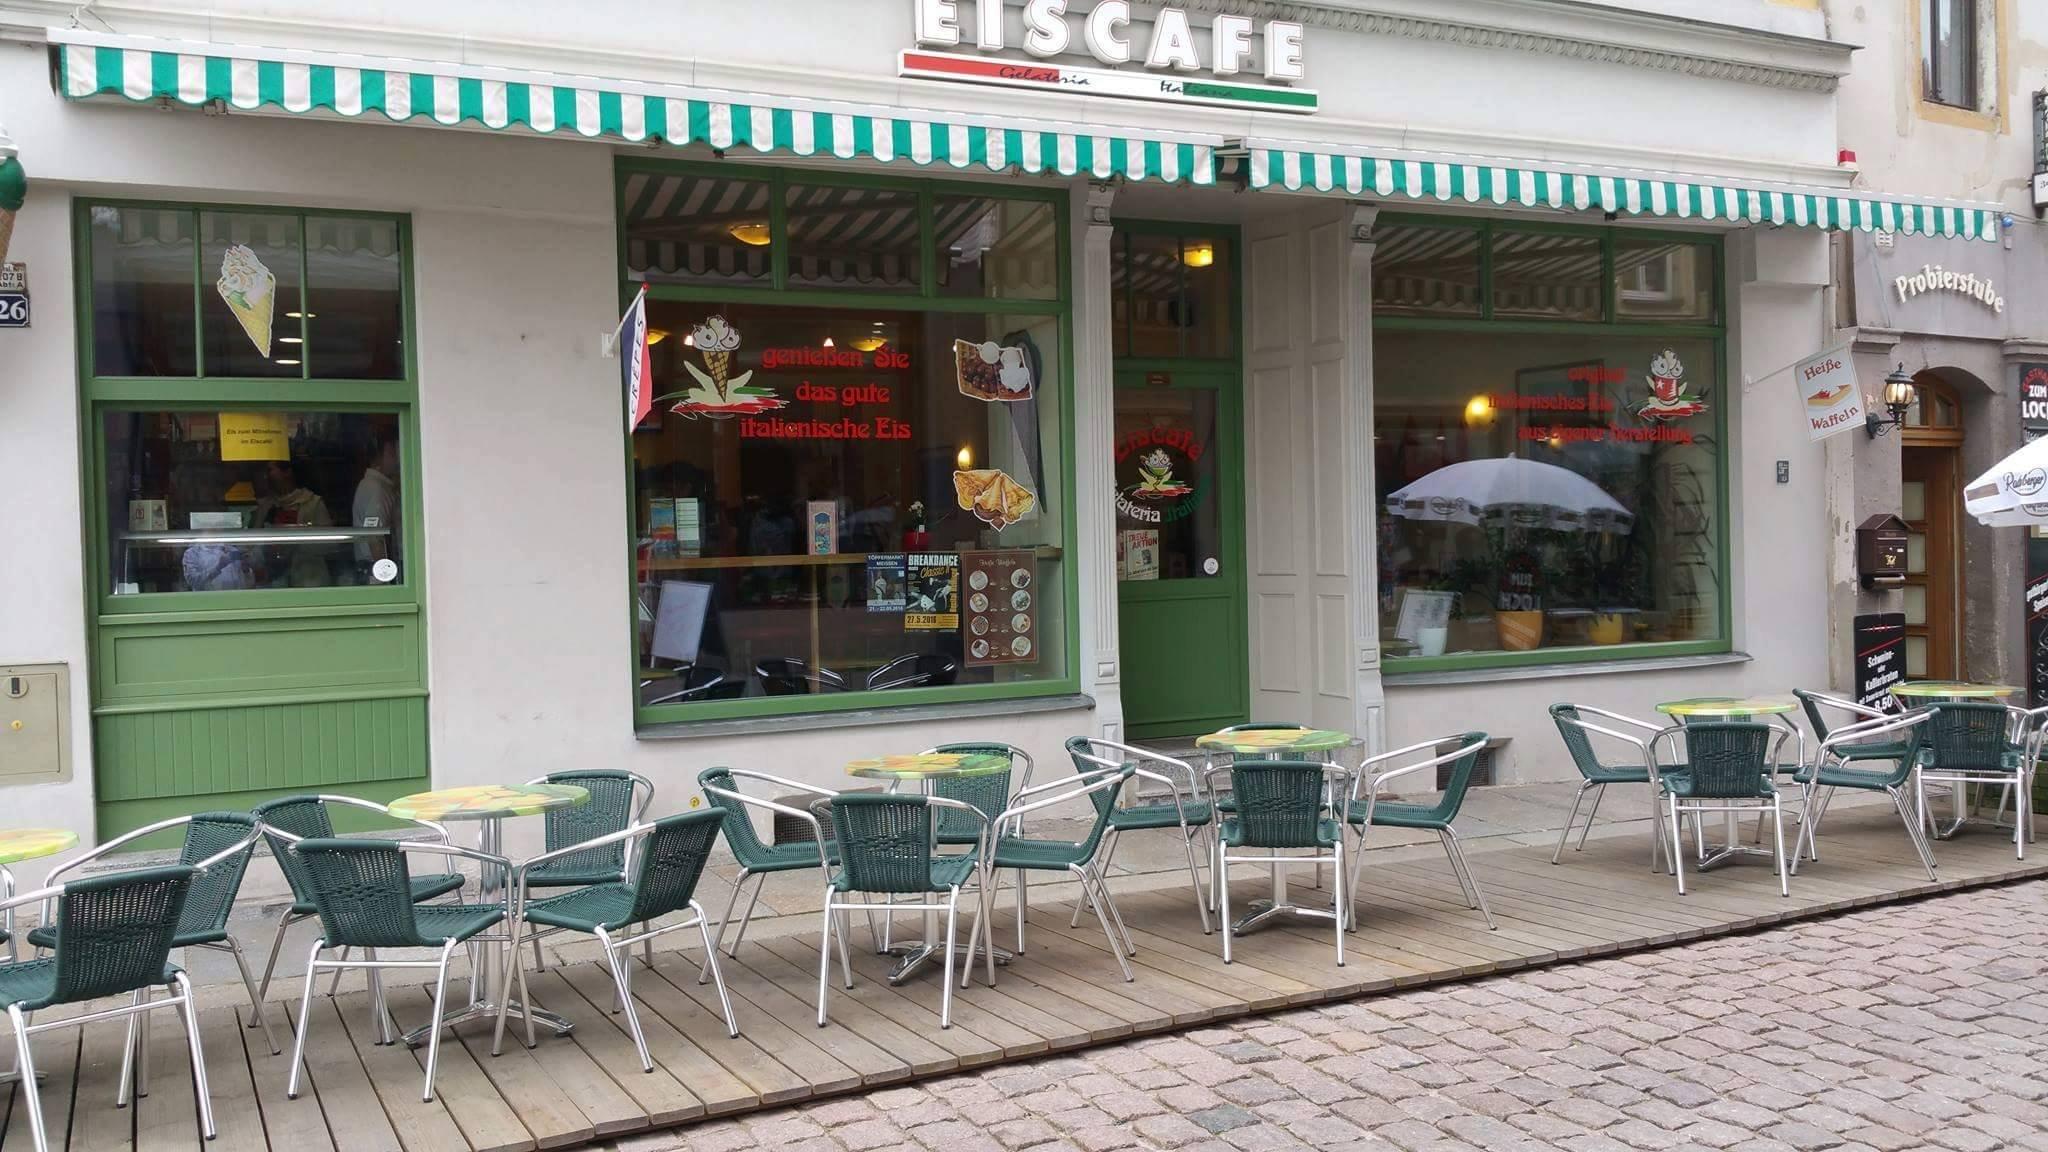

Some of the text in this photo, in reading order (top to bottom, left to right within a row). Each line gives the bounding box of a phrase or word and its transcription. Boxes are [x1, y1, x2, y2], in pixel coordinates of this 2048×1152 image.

[915, 0, 1304, 80] EISCAFE
[1000, 66, 1091, 87] Gelateria
[1896, 264, 2004, 313] Probierstube
[0, 300, 26, 320] 26
[762, 344, 909, 368] genießen Sie
[1804, 359, 1841, 381] Heiße
[796, 381, 890, 406] das gute
[2028, 384, 2047, 398] ZUM
[740, 416, 912, 439] italienische Eis
[1811, 405, 1859, 430] Waffeln
[1518, 426, 1546, 441] aus
[1131, 537, 1158, 549] AKTION
[908, 554, 959, 566] BREAKDANCE
